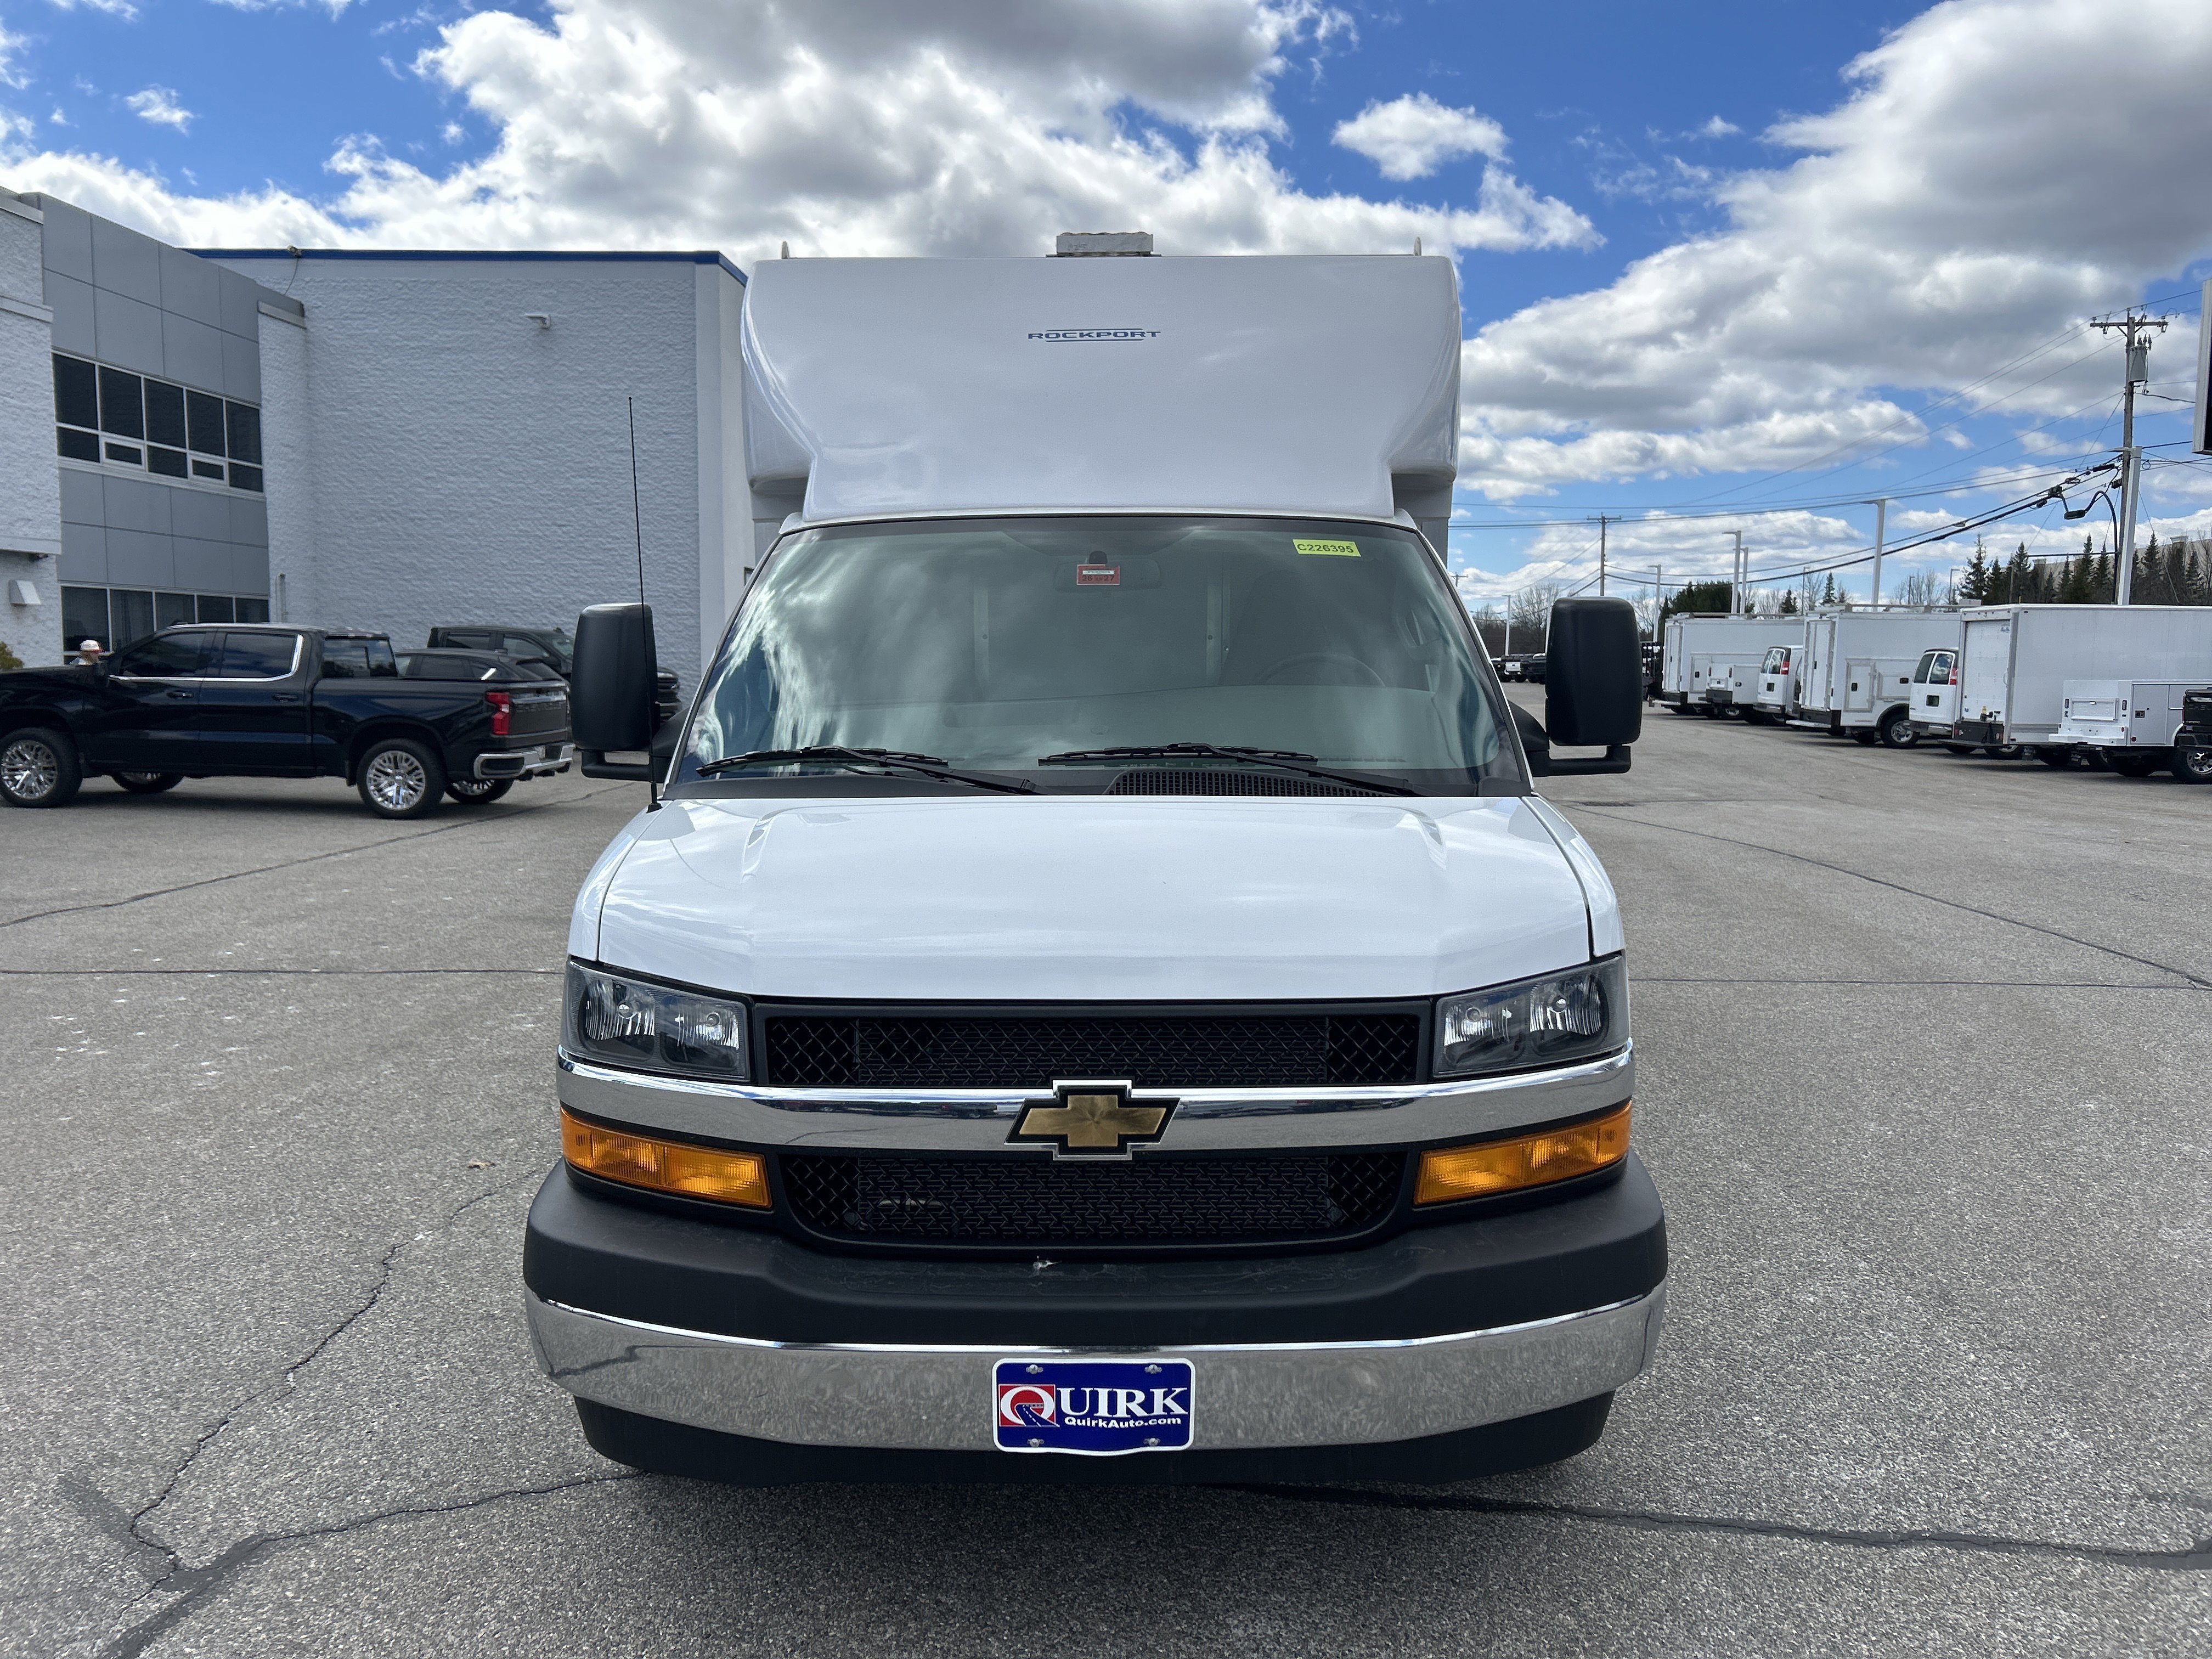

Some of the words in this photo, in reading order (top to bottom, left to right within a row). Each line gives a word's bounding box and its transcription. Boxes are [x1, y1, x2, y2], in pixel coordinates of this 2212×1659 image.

[1028, 331, 1161, 340] ROCKPORT
[1296, 544, 1354, 553] C226395
[1000, 1386, 1189, 1427] QUIRK
[1064, 1416, 1181, 1429] QuirkAuto.com
